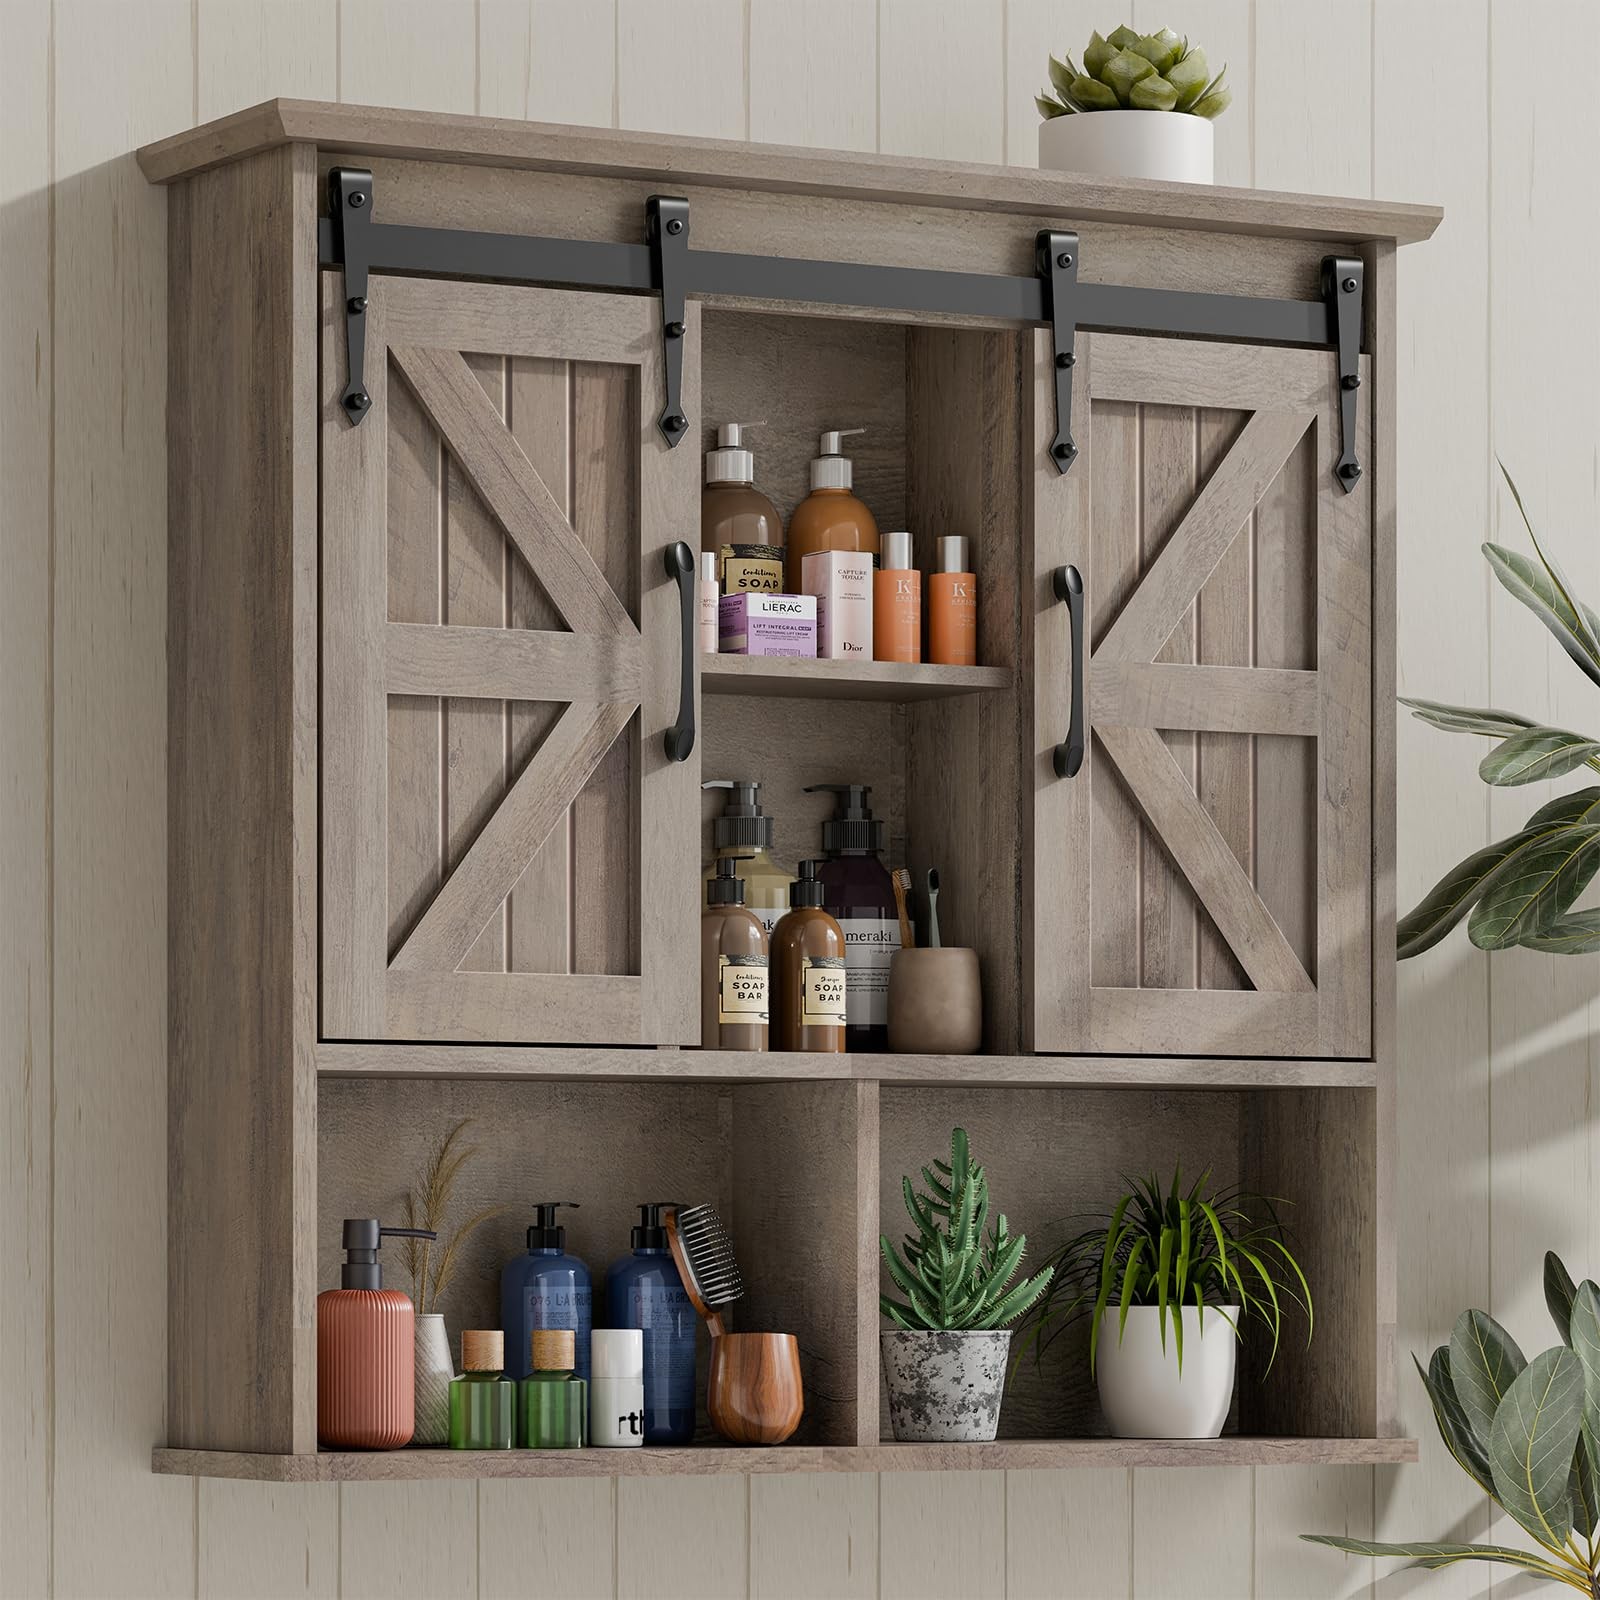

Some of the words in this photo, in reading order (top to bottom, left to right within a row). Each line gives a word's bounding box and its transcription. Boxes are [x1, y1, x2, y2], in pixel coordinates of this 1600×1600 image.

[837, 568, 868, 576] CAPTURE
[738, 579, 779, 589] SOAP
[762, 603, 802, 613] LIERAC
[843, 641, 864, 652] Dior
[845, 930, 892, 942] meraki
[732, 982, 765, 990] SOAP
[814, 984, 843, 992] SOAP
[737, 992, 762, 1000] BAR
[819, 993, 841, 1002] BAR
